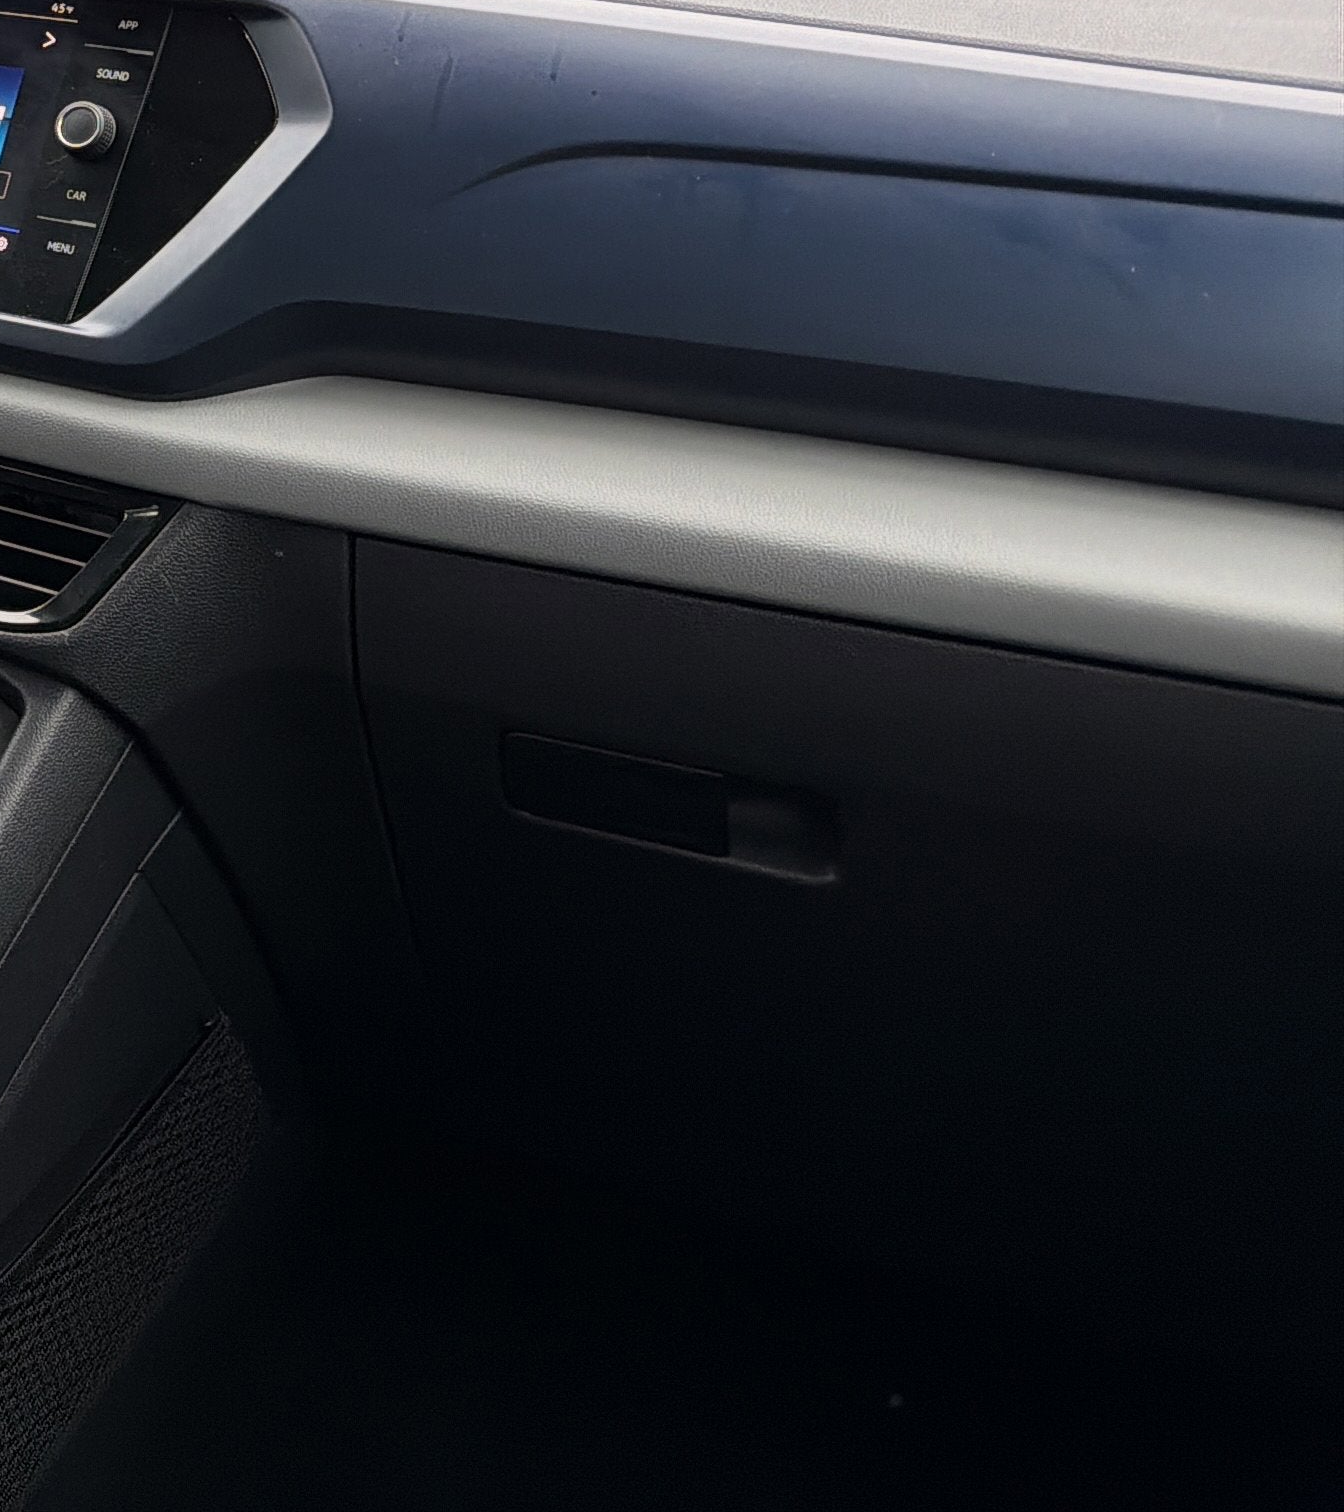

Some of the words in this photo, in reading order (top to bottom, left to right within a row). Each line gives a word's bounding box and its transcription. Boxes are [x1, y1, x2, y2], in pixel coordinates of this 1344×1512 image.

[118, 19, 139, 31] APP
[96, 68, 130, 82] SOUND
[66, 189, 87, 202] CAR
[46, 240, 76, 255] MENU
